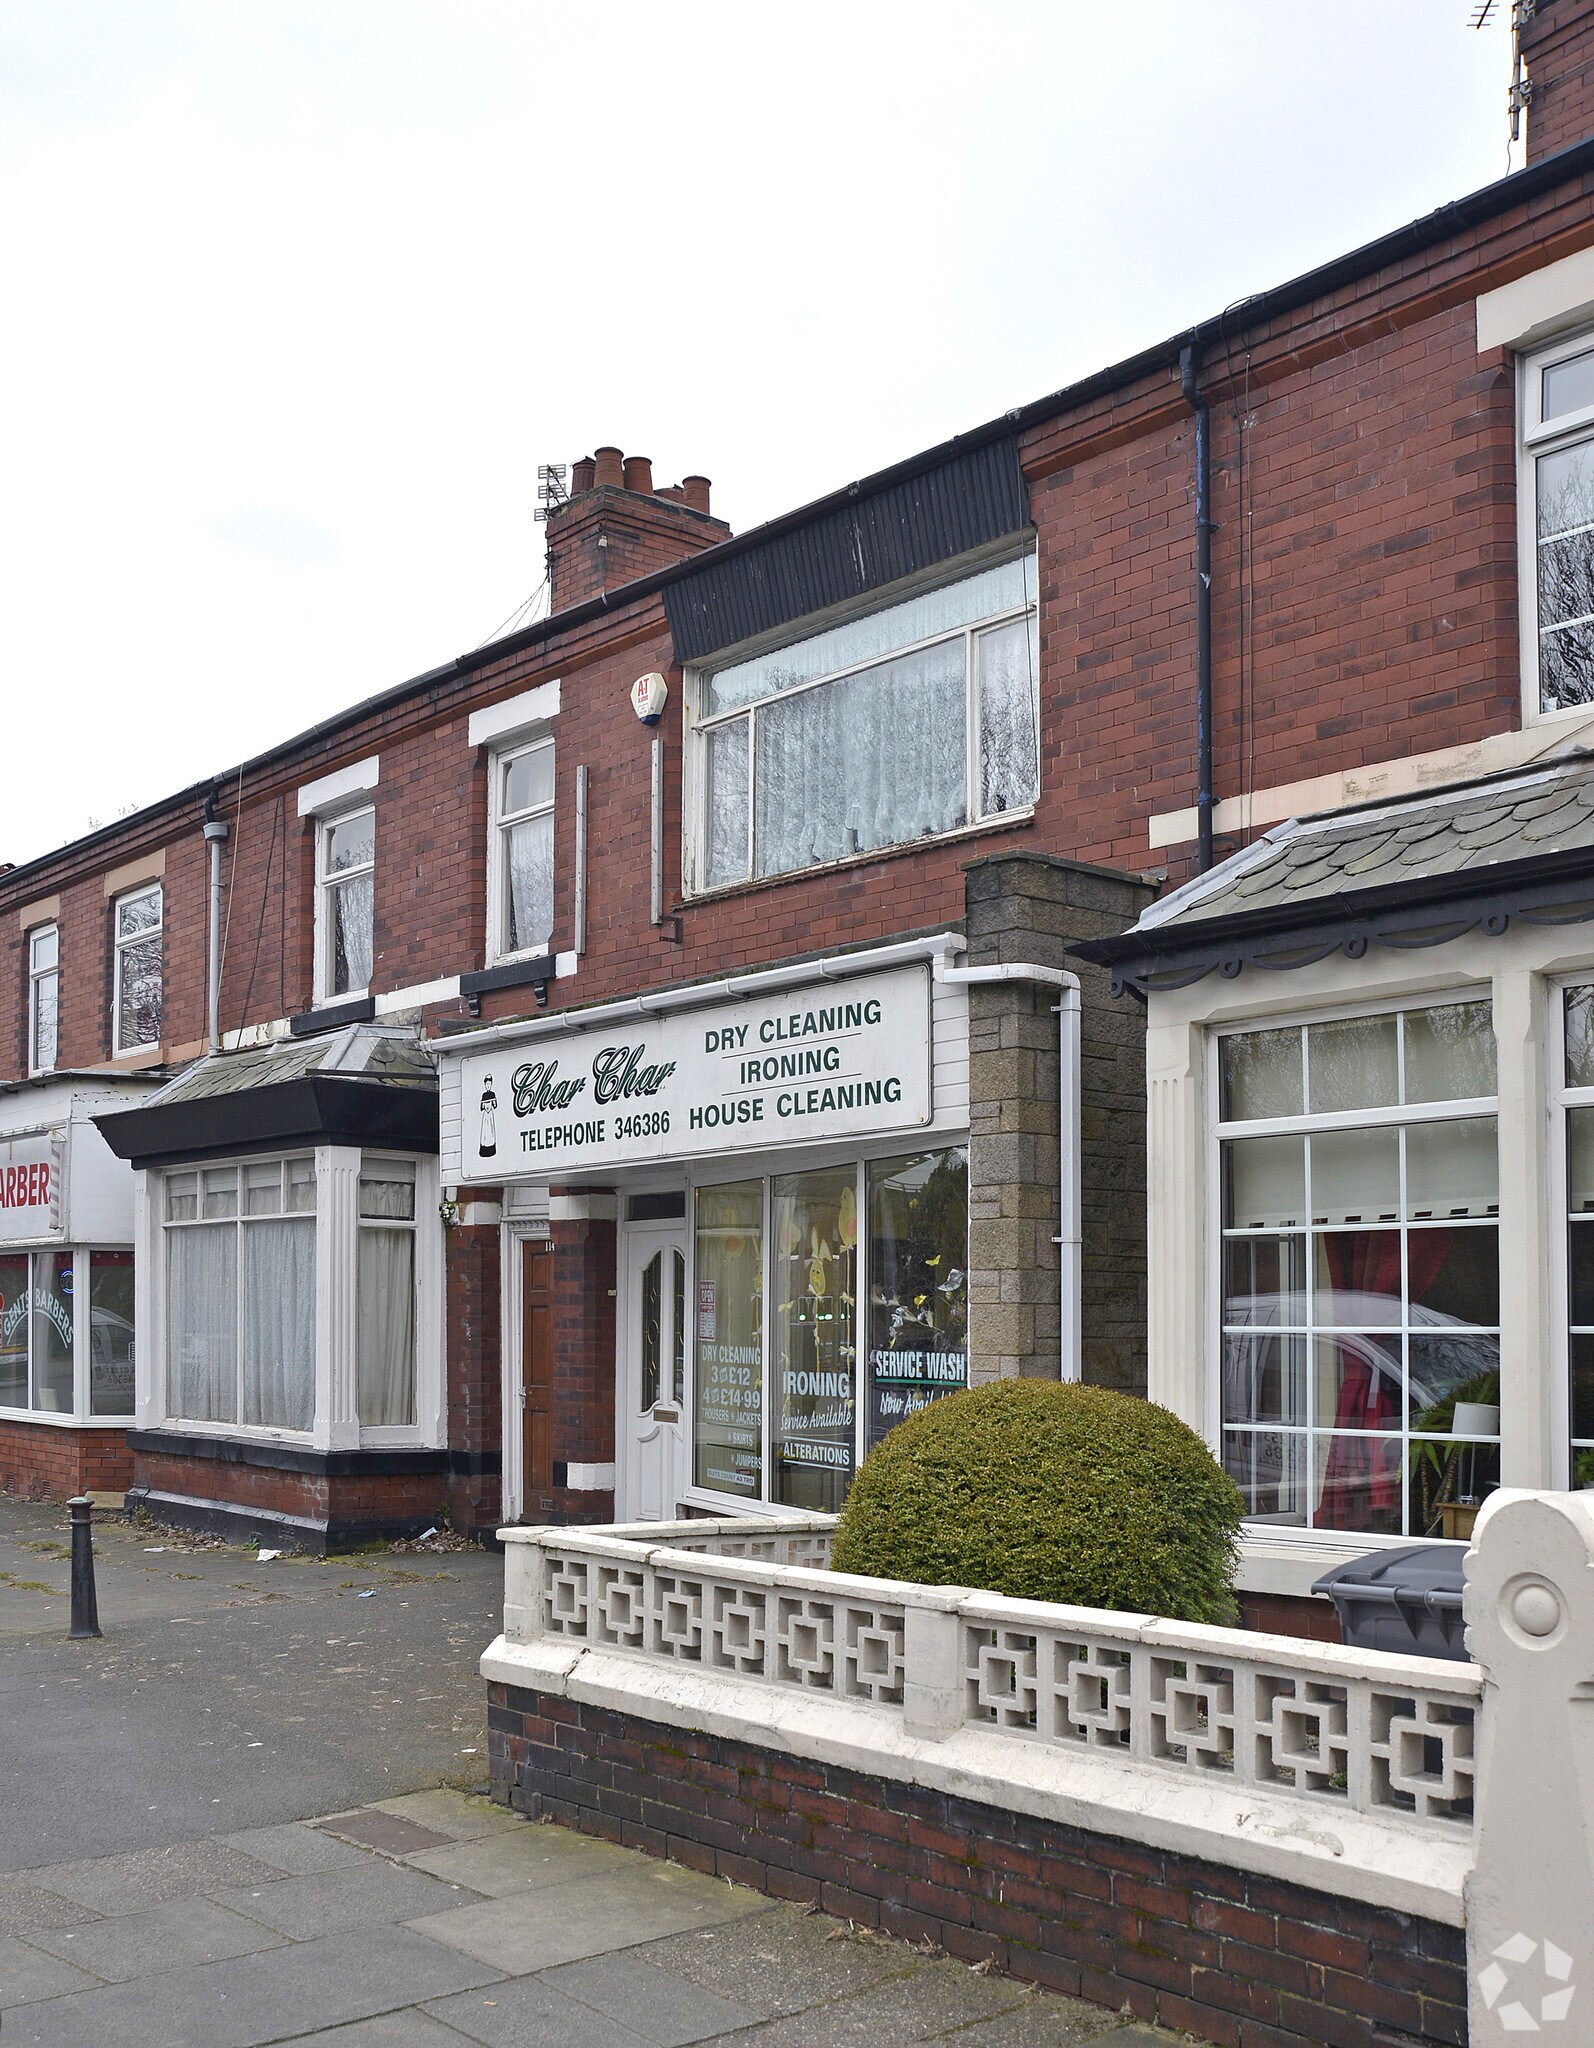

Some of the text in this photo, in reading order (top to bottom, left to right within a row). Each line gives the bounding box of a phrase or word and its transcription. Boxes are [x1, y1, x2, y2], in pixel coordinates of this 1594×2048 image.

[705, 999, 882, 1053] DRY CLEANING
[740, 1046, 841, 1084] IRONING
[510, 1043, 677, 1117] Char Char
[689, 1077, 902, 1130] HOUSE CLEANING
[520, 1110, 670, 1152] TELEPHONE 346386
[35, 1287, 74, 1344] BARBERS
[702, 1344, 761, 1366] DRY CLEANING
[875, 1350, 965, 1381] SERVICE WASH
[711, 1365, 719, 1383] 3
[728, 1366, 751, 1386] £12
[783, 1370, 849, 1398] IRONING
[703, 1387, 711, 1404] 4
[880, 1391, 904, 1416] Now
[702, 1407, 762, 1426] TROUSERS JACKETS
[780, 1402, 853, 1431] Service Available
[735, 1453, 762, 1470] JUMPERS
[783, 1442, 850, 1466] ALTERATIONS
